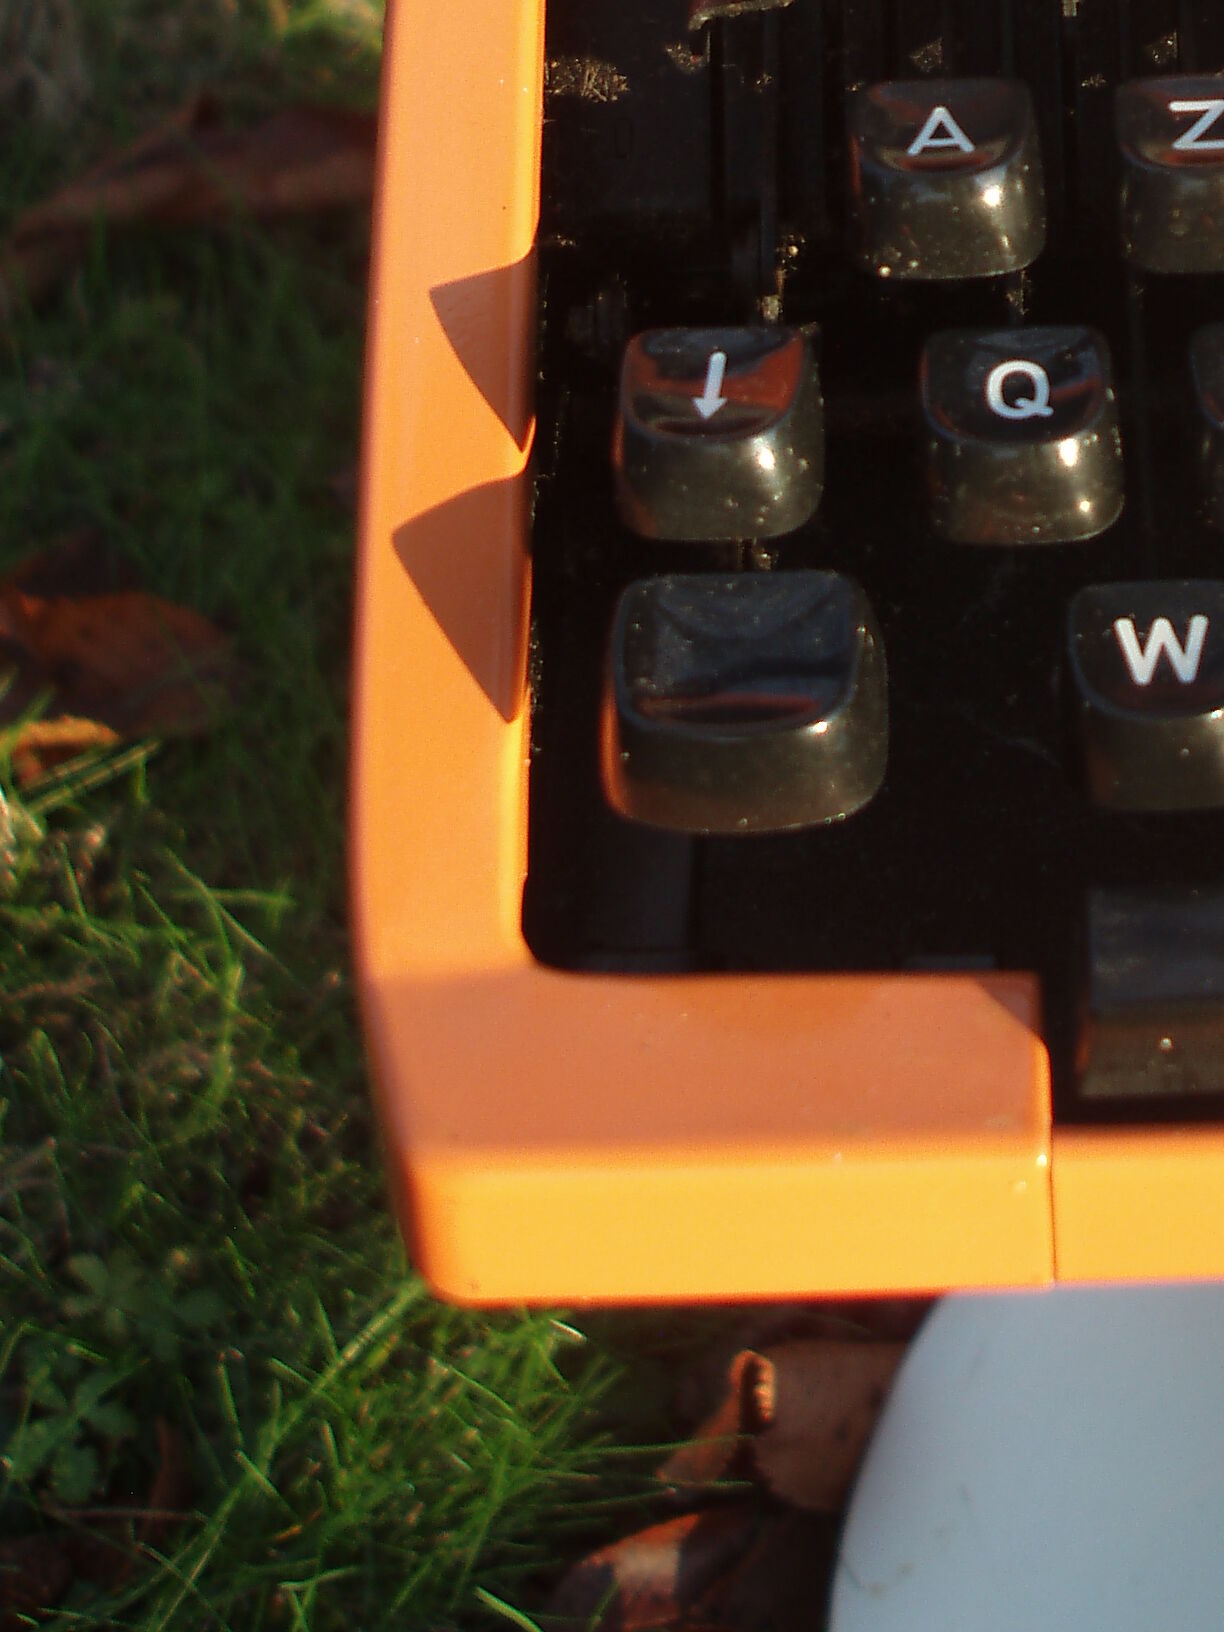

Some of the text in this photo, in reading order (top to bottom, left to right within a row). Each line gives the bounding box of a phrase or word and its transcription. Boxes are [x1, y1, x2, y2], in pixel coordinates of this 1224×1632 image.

[907, 106, 975, 156] A
[986, 360, 1049, 418] Q
[1115, 615, 1208, 685] W
